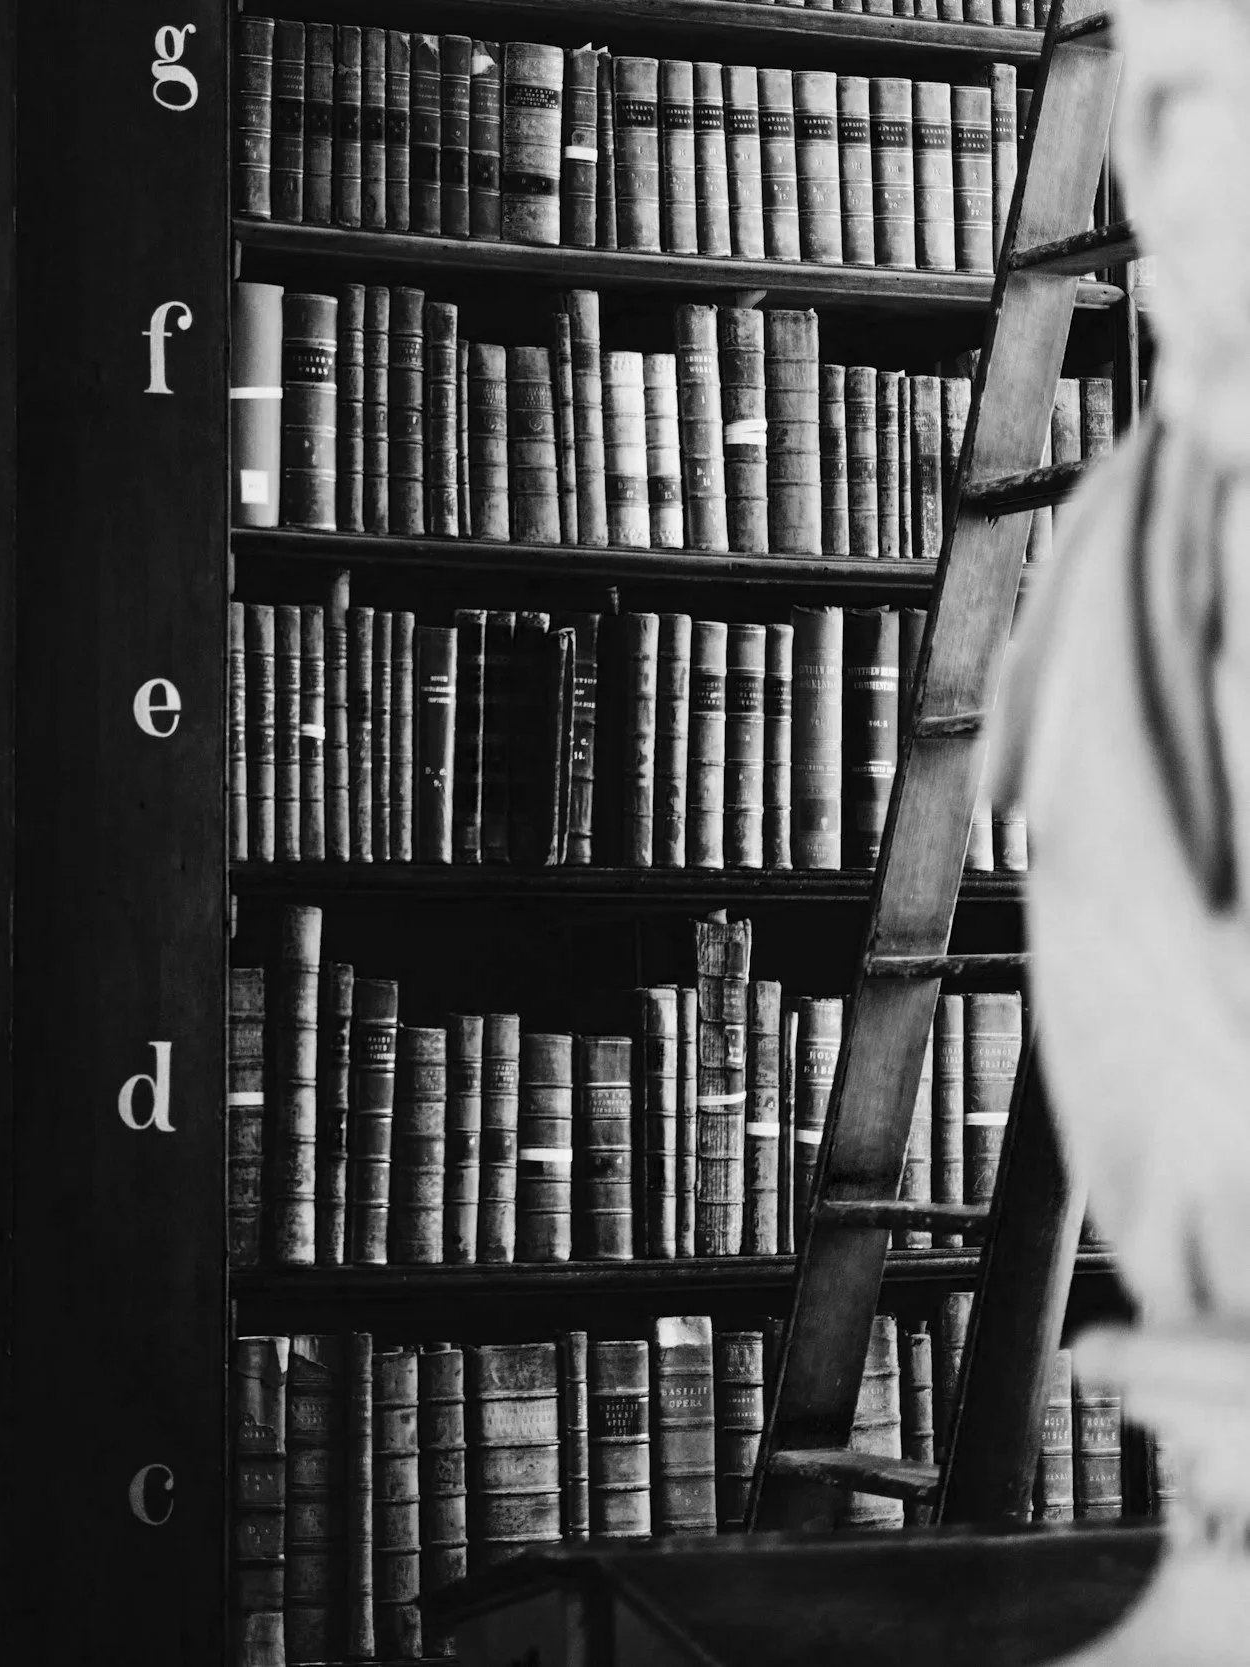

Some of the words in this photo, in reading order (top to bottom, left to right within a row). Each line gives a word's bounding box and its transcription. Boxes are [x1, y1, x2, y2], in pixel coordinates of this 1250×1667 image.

[152, 24, 198, 111] g
[142, 301, 192, 394] f
[133, 678, 181, 737] e
[118, 1041, 176, 1132] d
[660, 1387, 708, 1396] BASILII
[669, 1399, 702, 1408] OPERA
[1044, 1418, 1065, 1426] HOLY
[1087, 1417, 1112, 1427] HOLY
[1041, 1431, 1068, 1440] BIBLE
[1084, 1432, 1116, 1441] BIBLE
[129, 1464, 174, 1526] c
